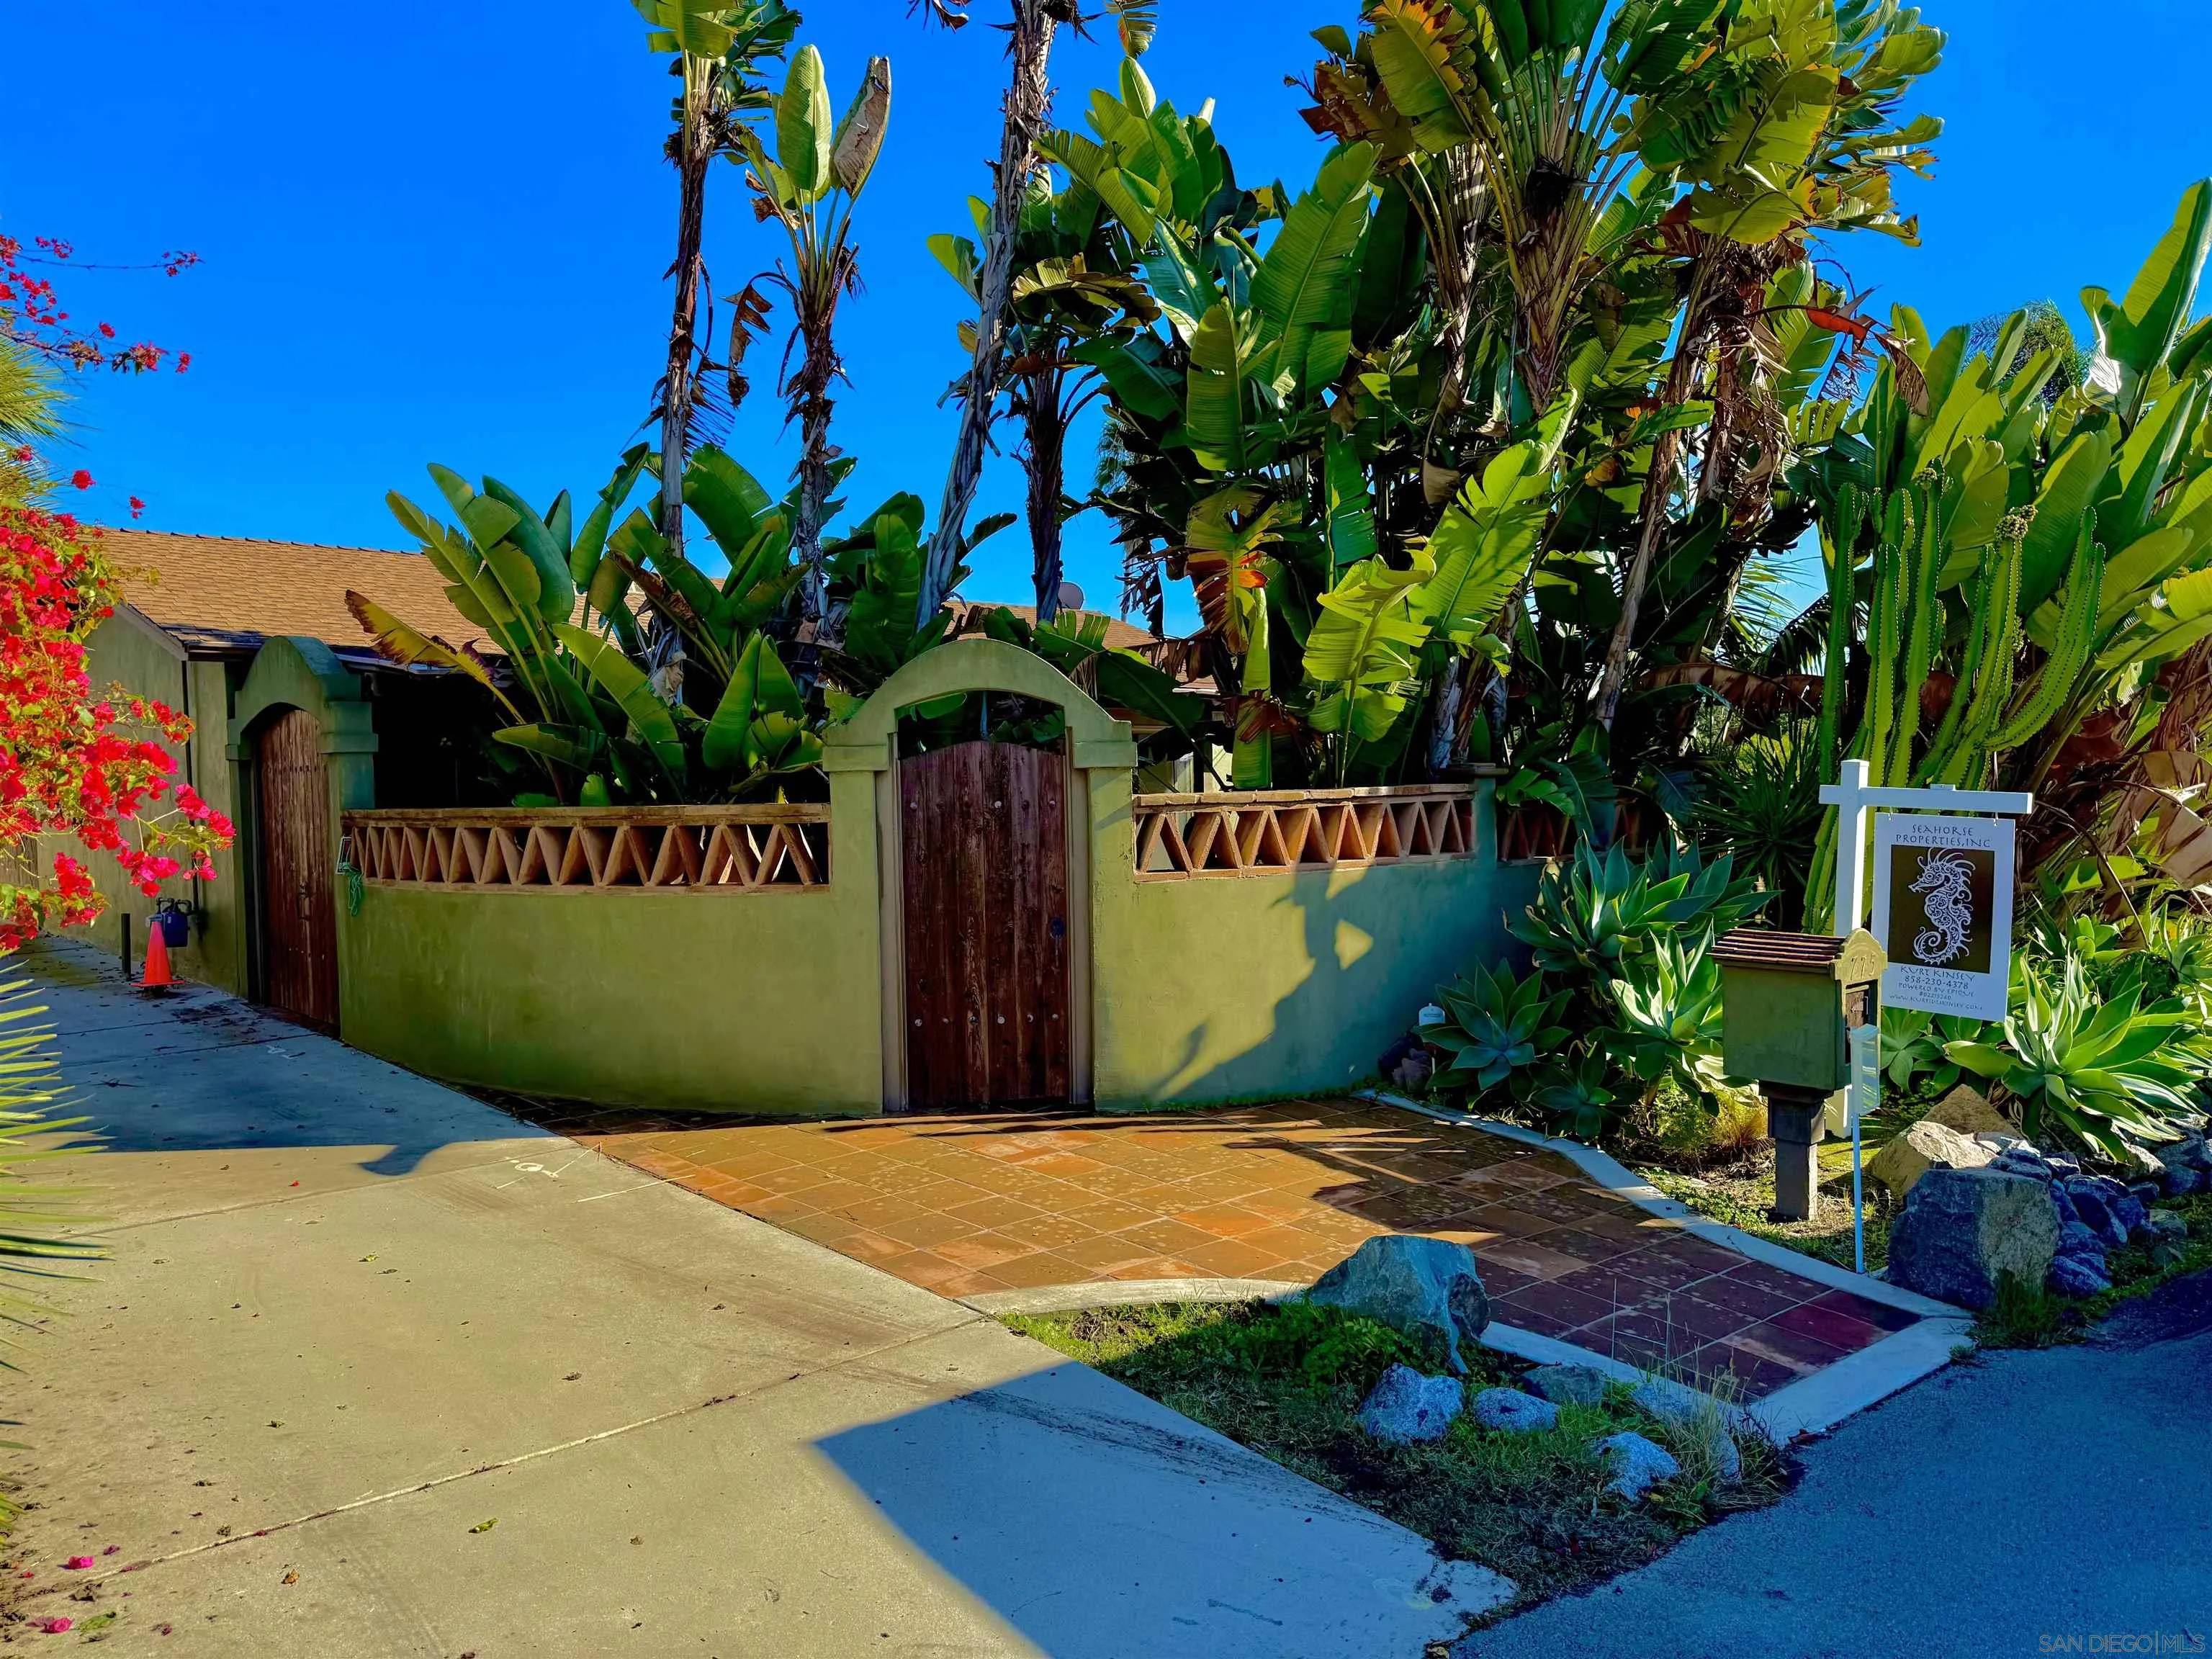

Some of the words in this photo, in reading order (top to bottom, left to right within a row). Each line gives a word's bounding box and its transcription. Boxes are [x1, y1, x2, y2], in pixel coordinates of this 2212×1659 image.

[1912, 824, 1974, 836] SEAHORSE
[1850, 953, 1876, 980] 775
[1900, 966, 1930, 976] KURT
[1933, 968, 1975, 982] KINSEY
[1898, 982, 1931, 992] POWERED
[1905, 975, 1969, 989] 858-230-4378
